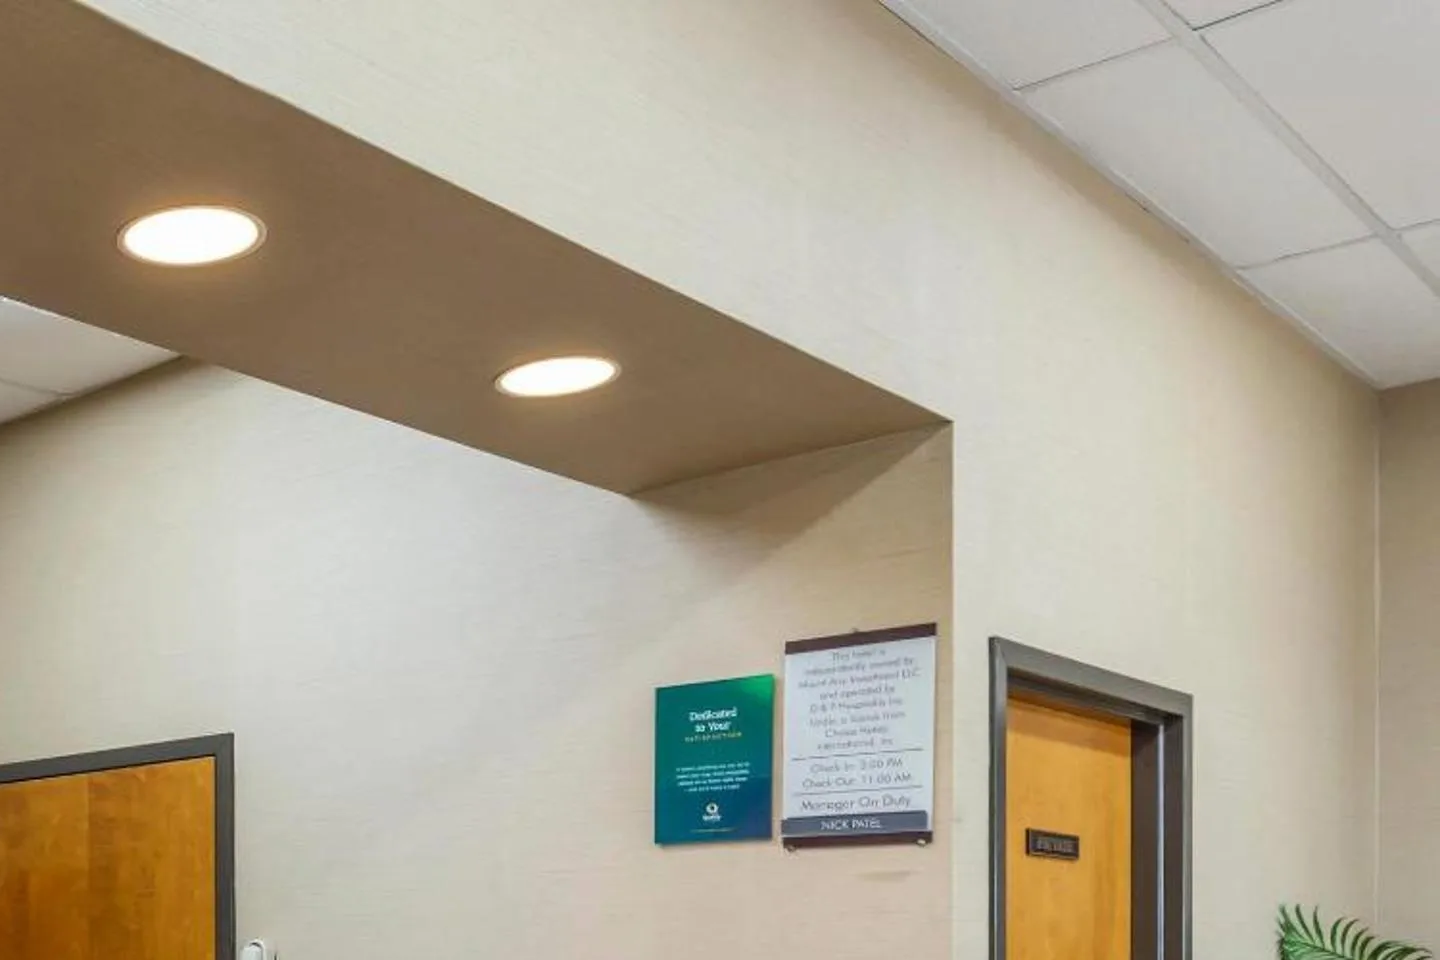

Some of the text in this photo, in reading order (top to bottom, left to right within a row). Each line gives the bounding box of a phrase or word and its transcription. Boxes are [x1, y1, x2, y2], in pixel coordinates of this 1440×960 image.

[688, 706, 738, 721] Dedicated
[707, 721, 732, 732] Your
[809, 761, 841, 774] Check
[886, 757, 904, 768] PM
[801, 777, 833, 790] Check
[893, 772, 912, 783] AM
[801, 793, 912, 811] Manager On Duty
[820, 818, 882, 831] NICK PATEL
